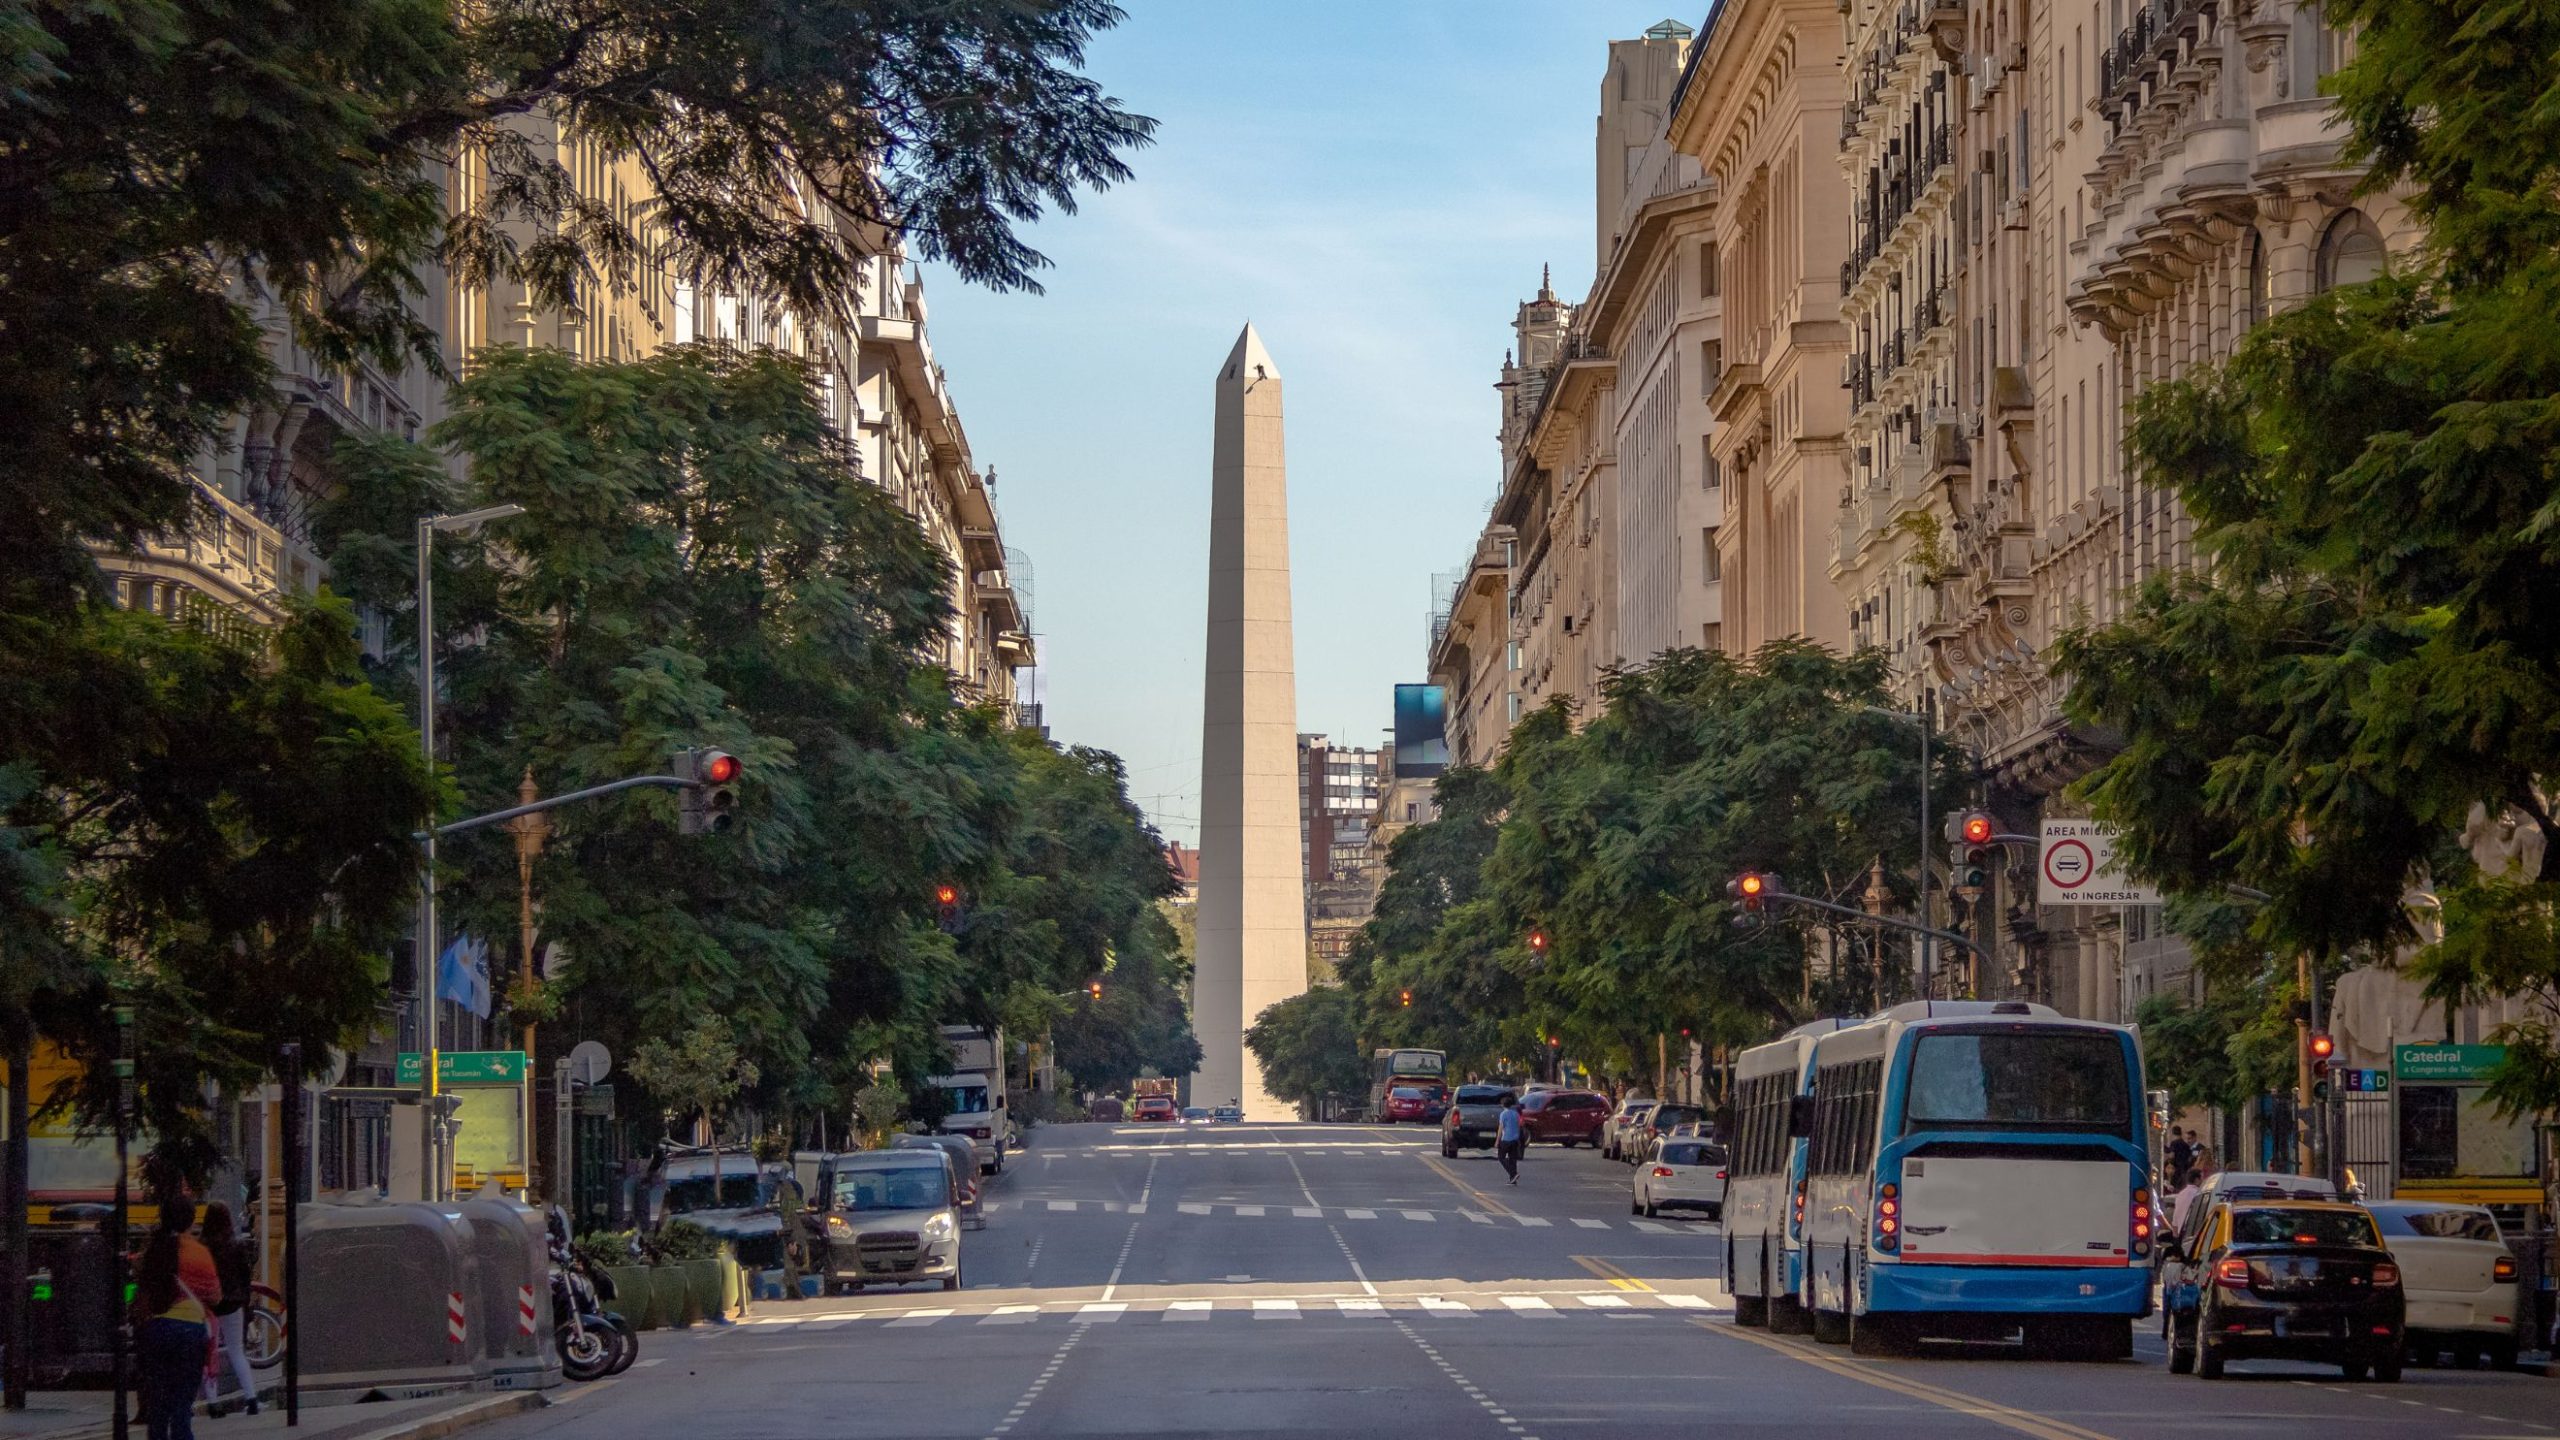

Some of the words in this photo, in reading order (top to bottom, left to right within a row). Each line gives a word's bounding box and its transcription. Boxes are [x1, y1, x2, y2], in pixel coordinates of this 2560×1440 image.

[2046, 827, 2076, 836] AREA
[2062, 892, 2078, 900] NO
[2083, 892, 2140, 900] INGRESAR
[2403, 1050, 2461, 1063] Catedral
[403, 1057, 454, 1069] Catral
[2351, 1073, 2358, 1086] E
[2362, 1073, 2373, 1086] A
[2376, 1075, 2386, 1087] D
